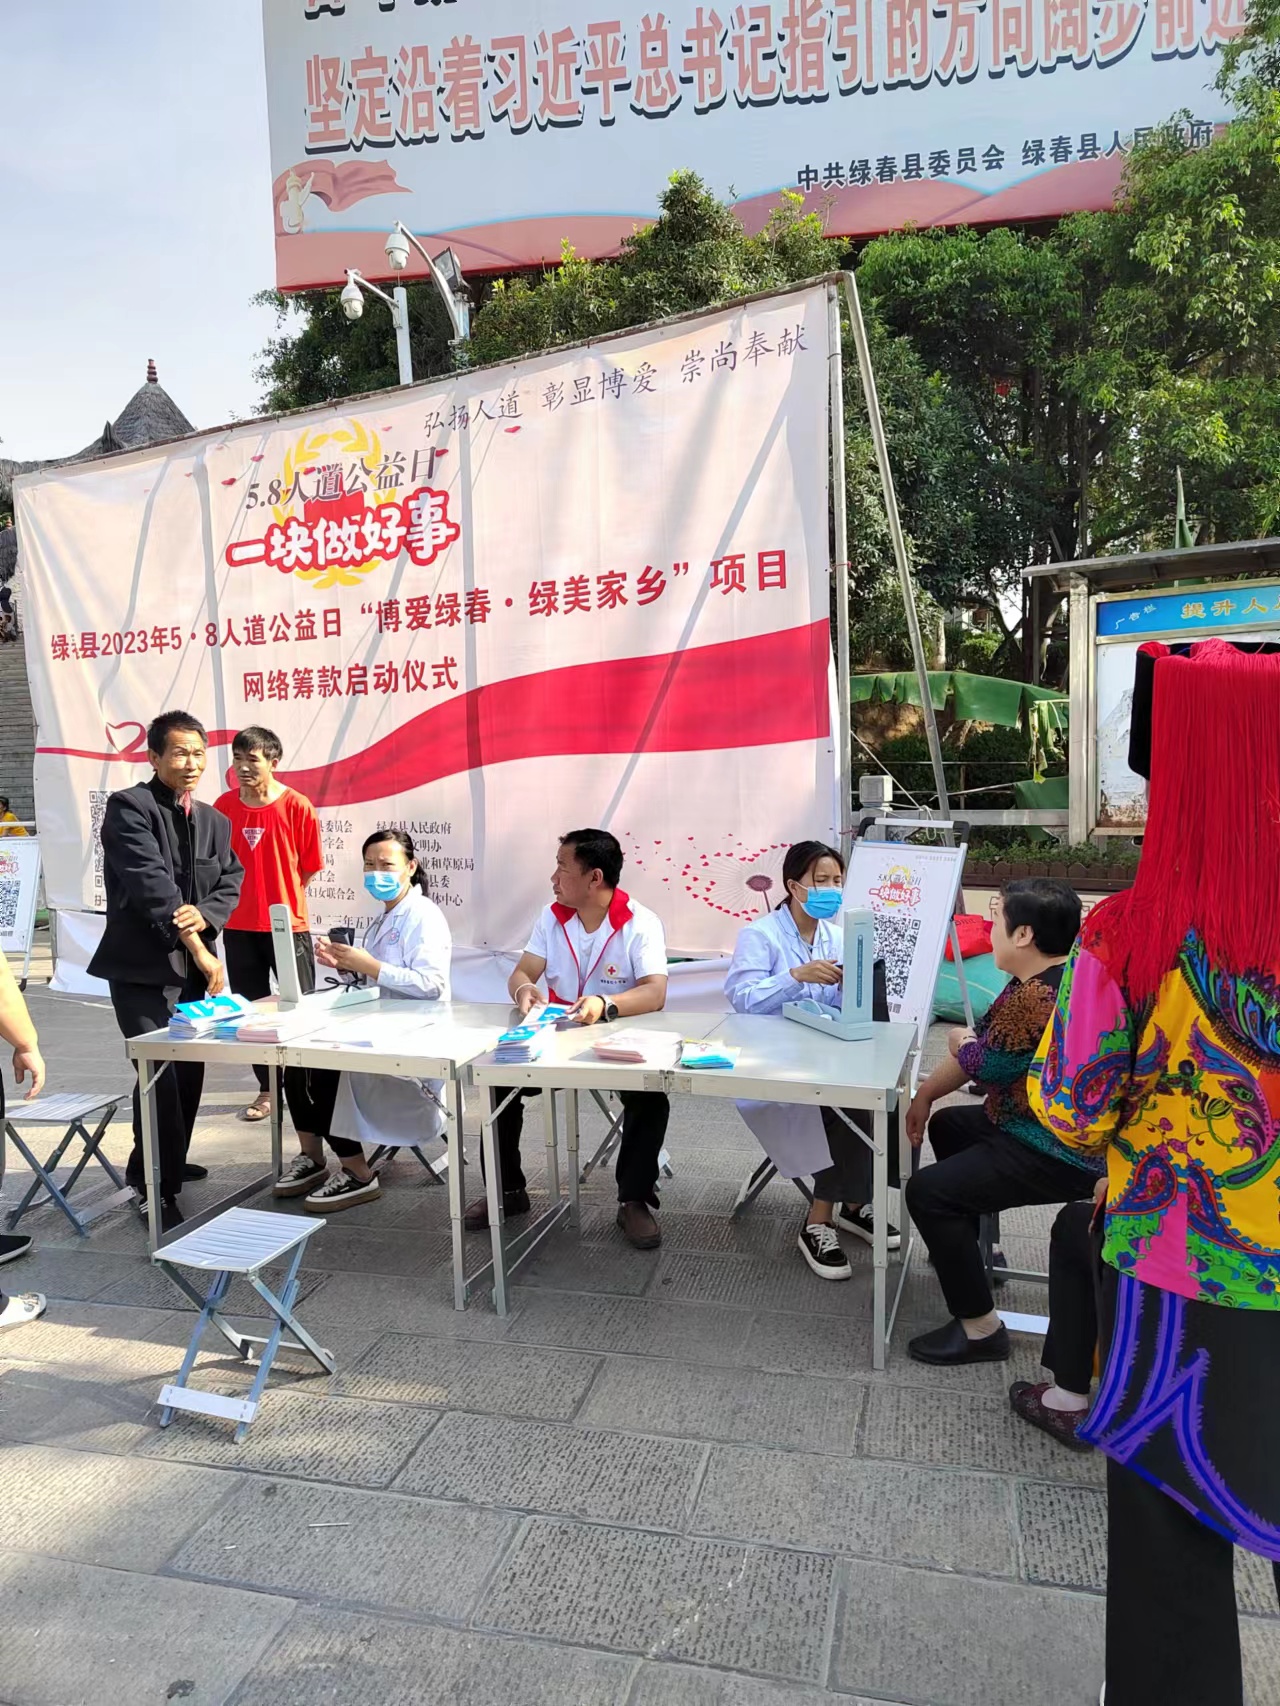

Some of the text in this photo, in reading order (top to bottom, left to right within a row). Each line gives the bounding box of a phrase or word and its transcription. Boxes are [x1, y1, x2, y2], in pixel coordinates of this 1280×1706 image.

[797, 145, 1006, 193] 中共绿春县委员会
[424, 324, 809, 438] 弘扬人道 彰显博爱 崇尚奉献
[245, 446, 437, 510] 5.8人道公益日
[229, 492, 457, 570] 一块做好事
[1181, 594, 1280, 619] 提升人
[243, 656, 458, 703] 网络筹款启动仪式
[305, 886, 355, 900] 妇女联合会
